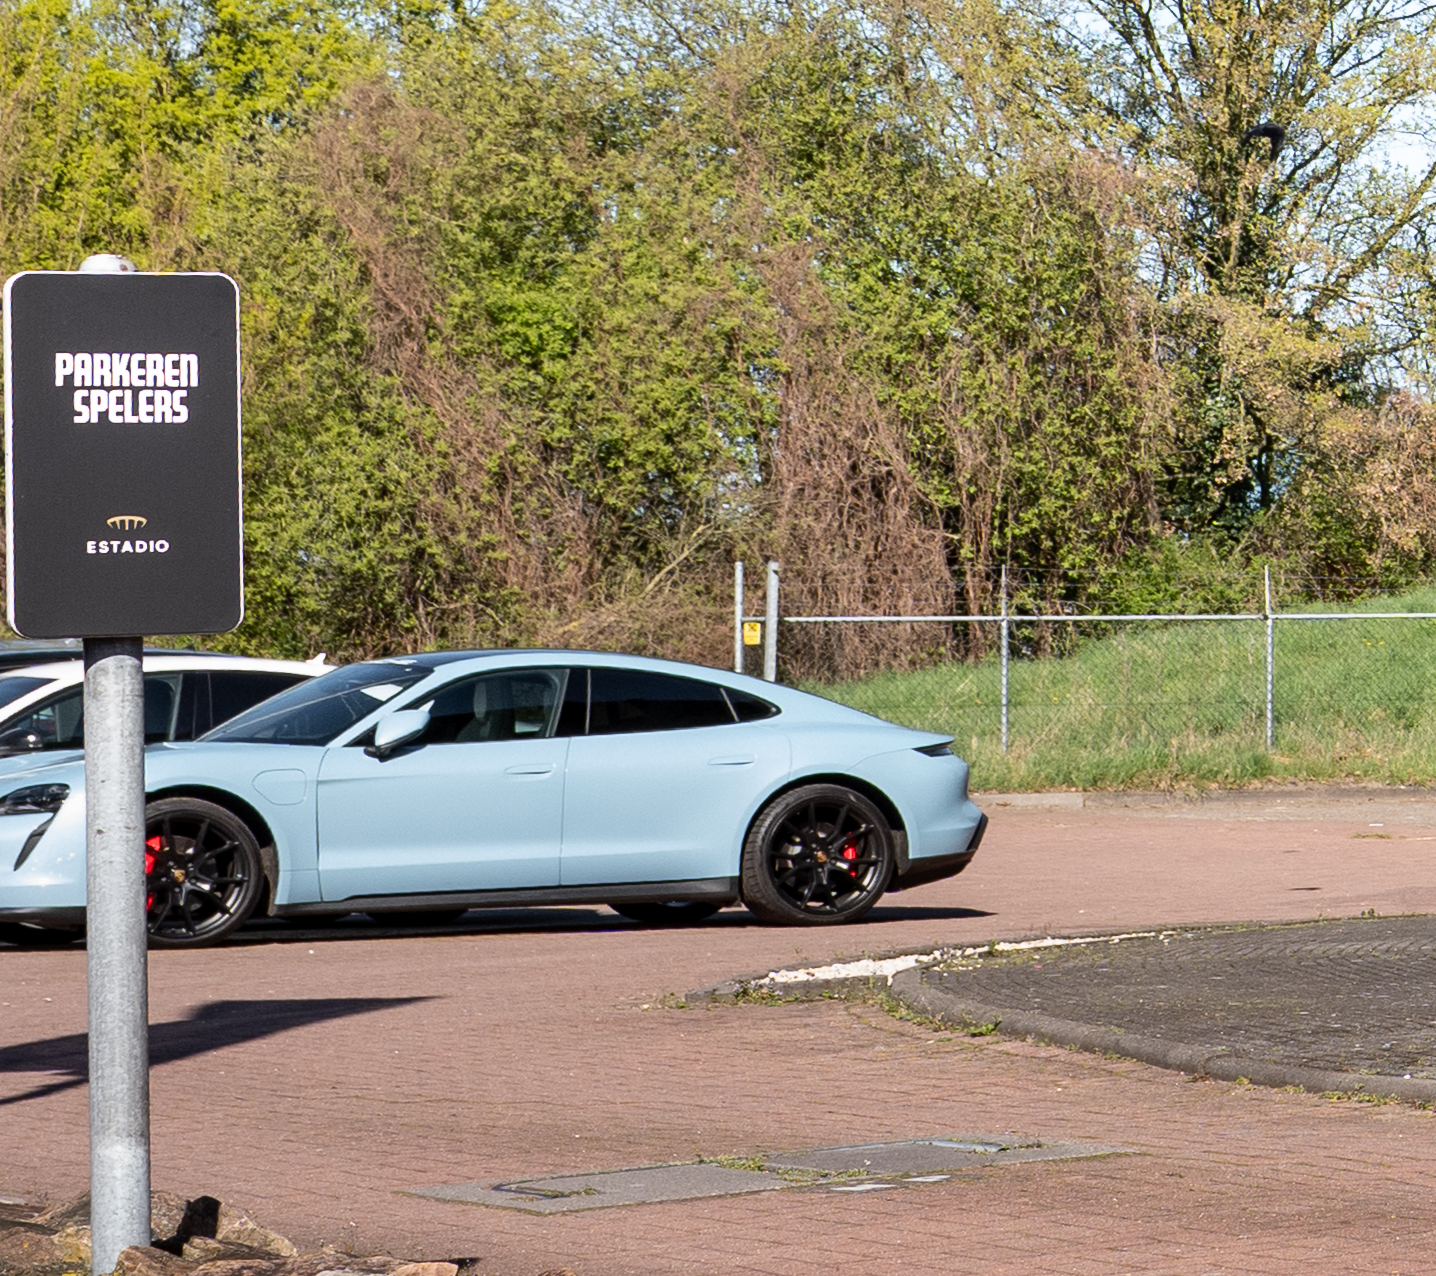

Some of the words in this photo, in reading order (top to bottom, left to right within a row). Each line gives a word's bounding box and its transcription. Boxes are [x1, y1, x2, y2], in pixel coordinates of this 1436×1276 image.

[55, 352, 199, 388] PARKEREN
[73, 390, 189, 424] SPELERS
[86, 540, 170, 554] ESTADIO
